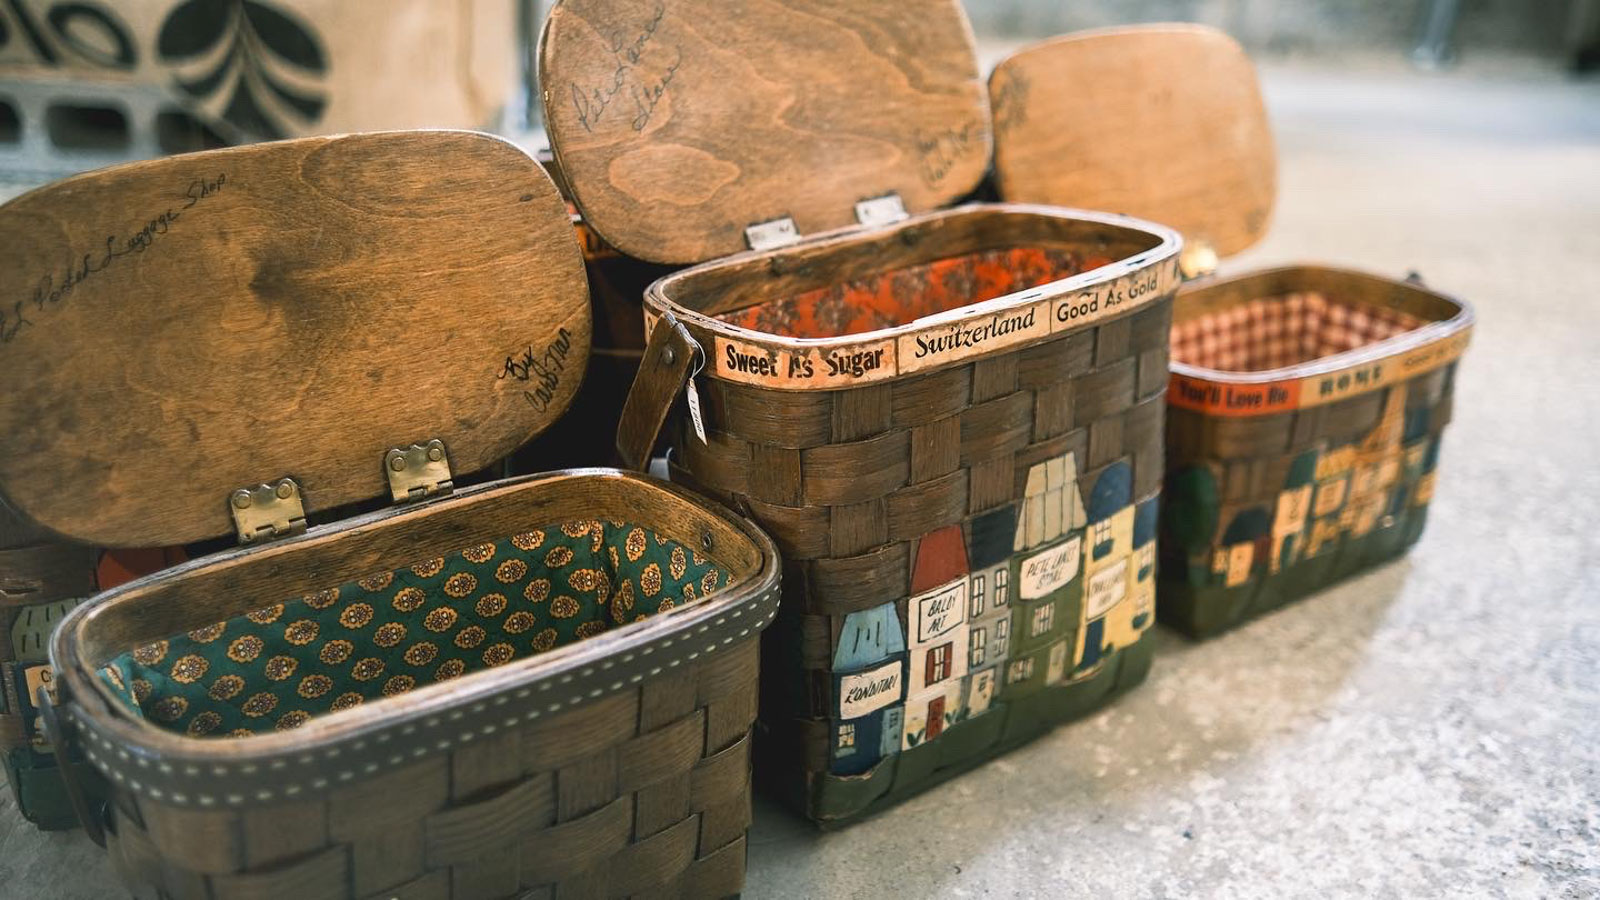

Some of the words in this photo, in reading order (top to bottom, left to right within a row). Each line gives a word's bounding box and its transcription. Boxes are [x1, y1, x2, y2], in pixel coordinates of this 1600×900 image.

[100, 208, 181, 269] Luggage
[182, 172, 226, 210] Shop
[1057, 292, 1099, 322] Good
[1104, 289, 1122, 308] As
[1128, 273, 1158, 299] Gold
[914, 307, 1036, 358] Switzerland
[497, 345, 548, 380] By
[726, 343, 778, 377] Sweet
[825, 348, 884, 378] Sugar
[1226, 386, 1264, 409] Love
